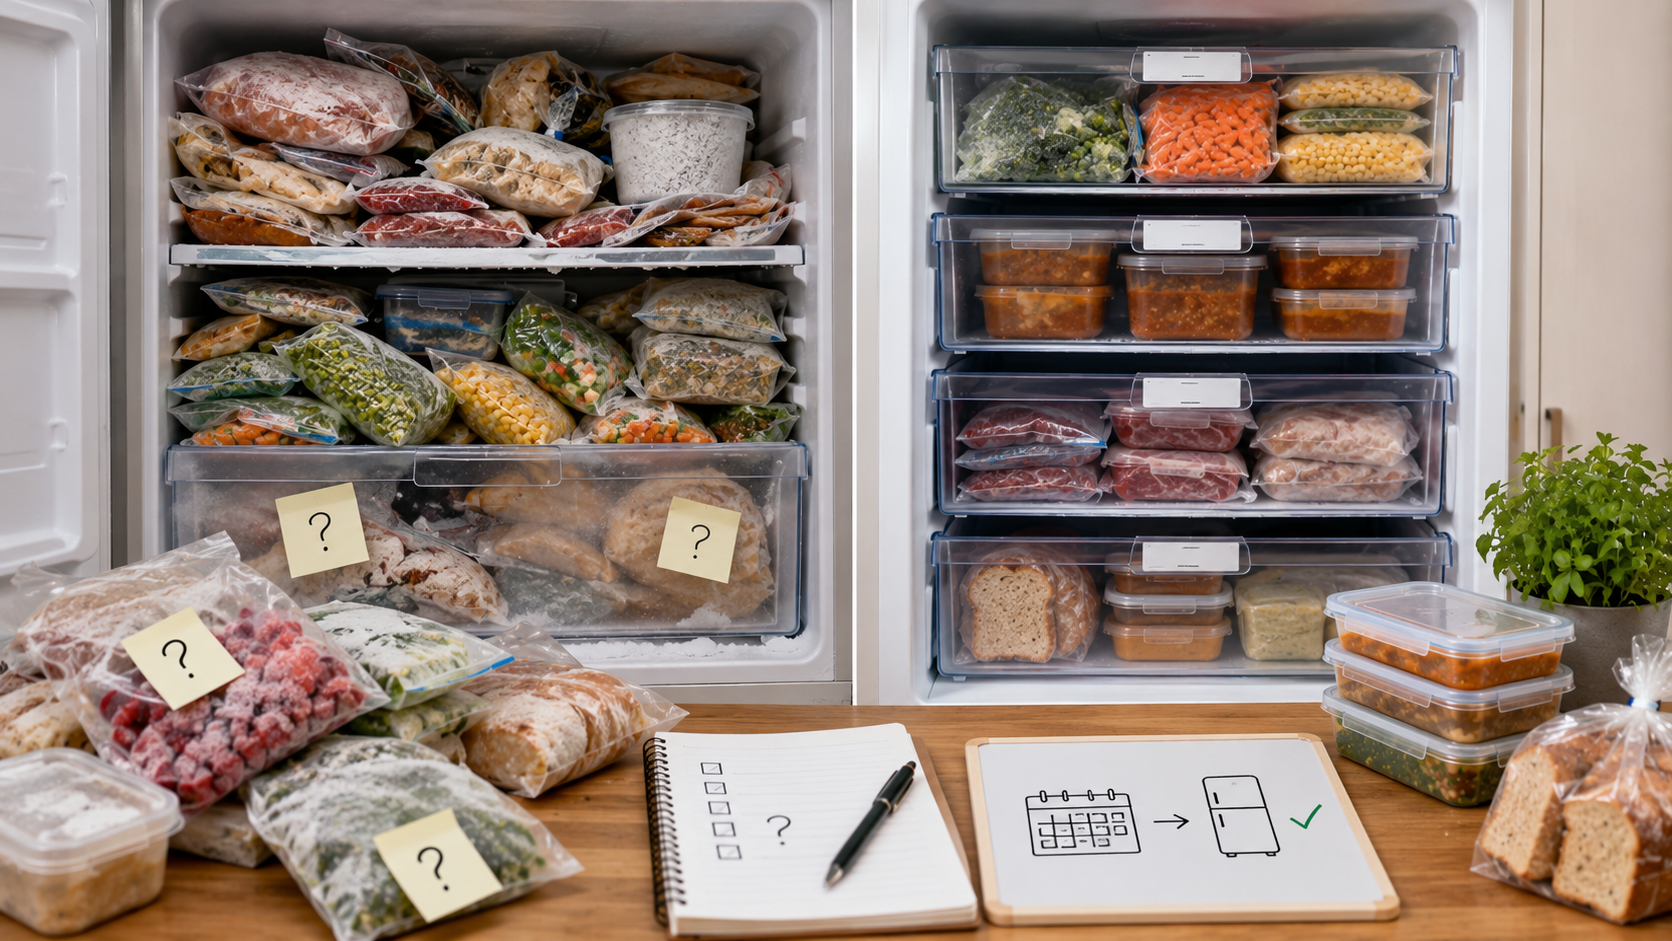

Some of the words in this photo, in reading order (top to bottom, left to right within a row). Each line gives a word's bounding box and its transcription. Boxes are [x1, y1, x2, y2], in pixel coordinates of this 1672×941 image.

[308, 511, 332, 552] ?
[690, 523, 711, 560] ?
[161, 638, 195, 679] ?
[766, 814, 793, 847] ?
[416, 845, 450, 892] ?
